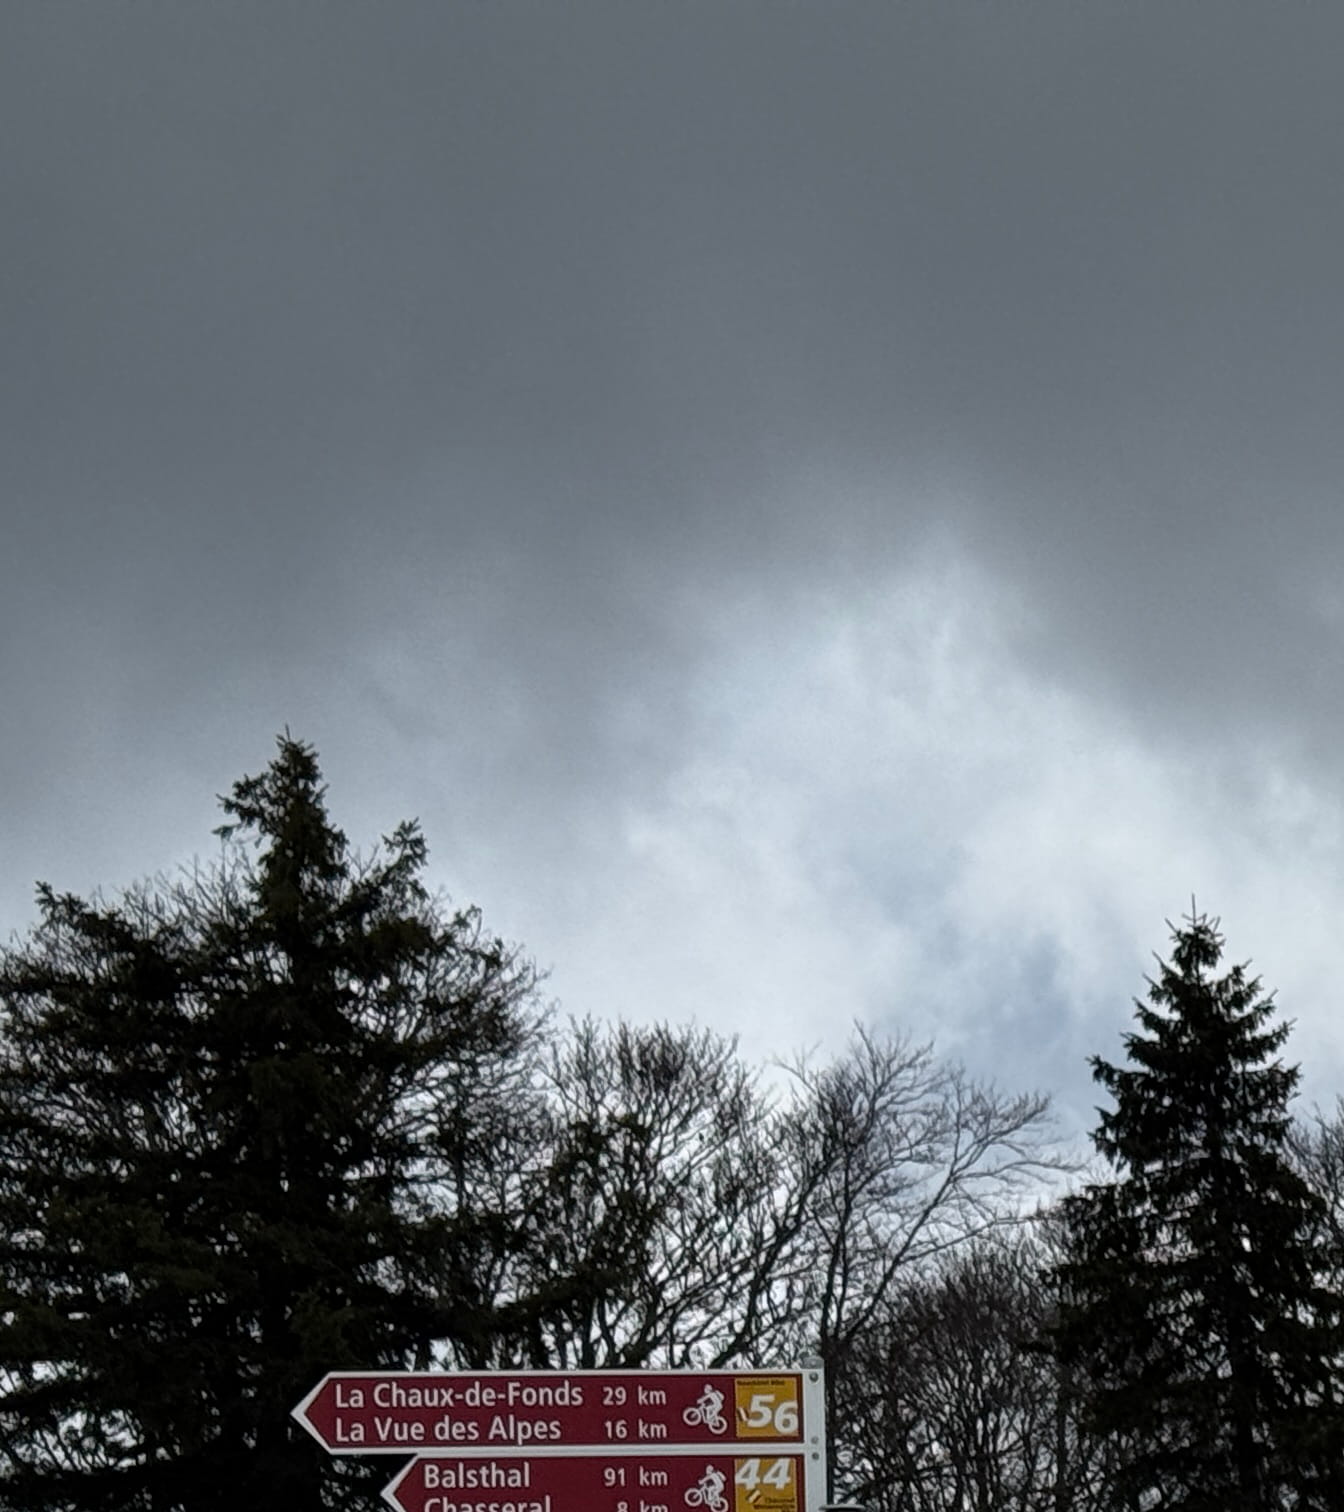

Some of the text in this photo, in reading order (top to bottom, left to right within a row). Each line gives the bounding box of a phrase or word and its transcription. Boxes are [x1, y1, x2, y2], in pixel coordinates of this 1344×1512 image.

[336, 1380, 667, 1408] La Chaux-de-Fonds 29 km
[336, 1414, 667, 1445] La Vue des Alpes 16 km
[748, 1395, 799, 1434] 56
[424, 1462, 668, 1488] Balsthal 91 km
[735, 1458, 791, 1490] 44
